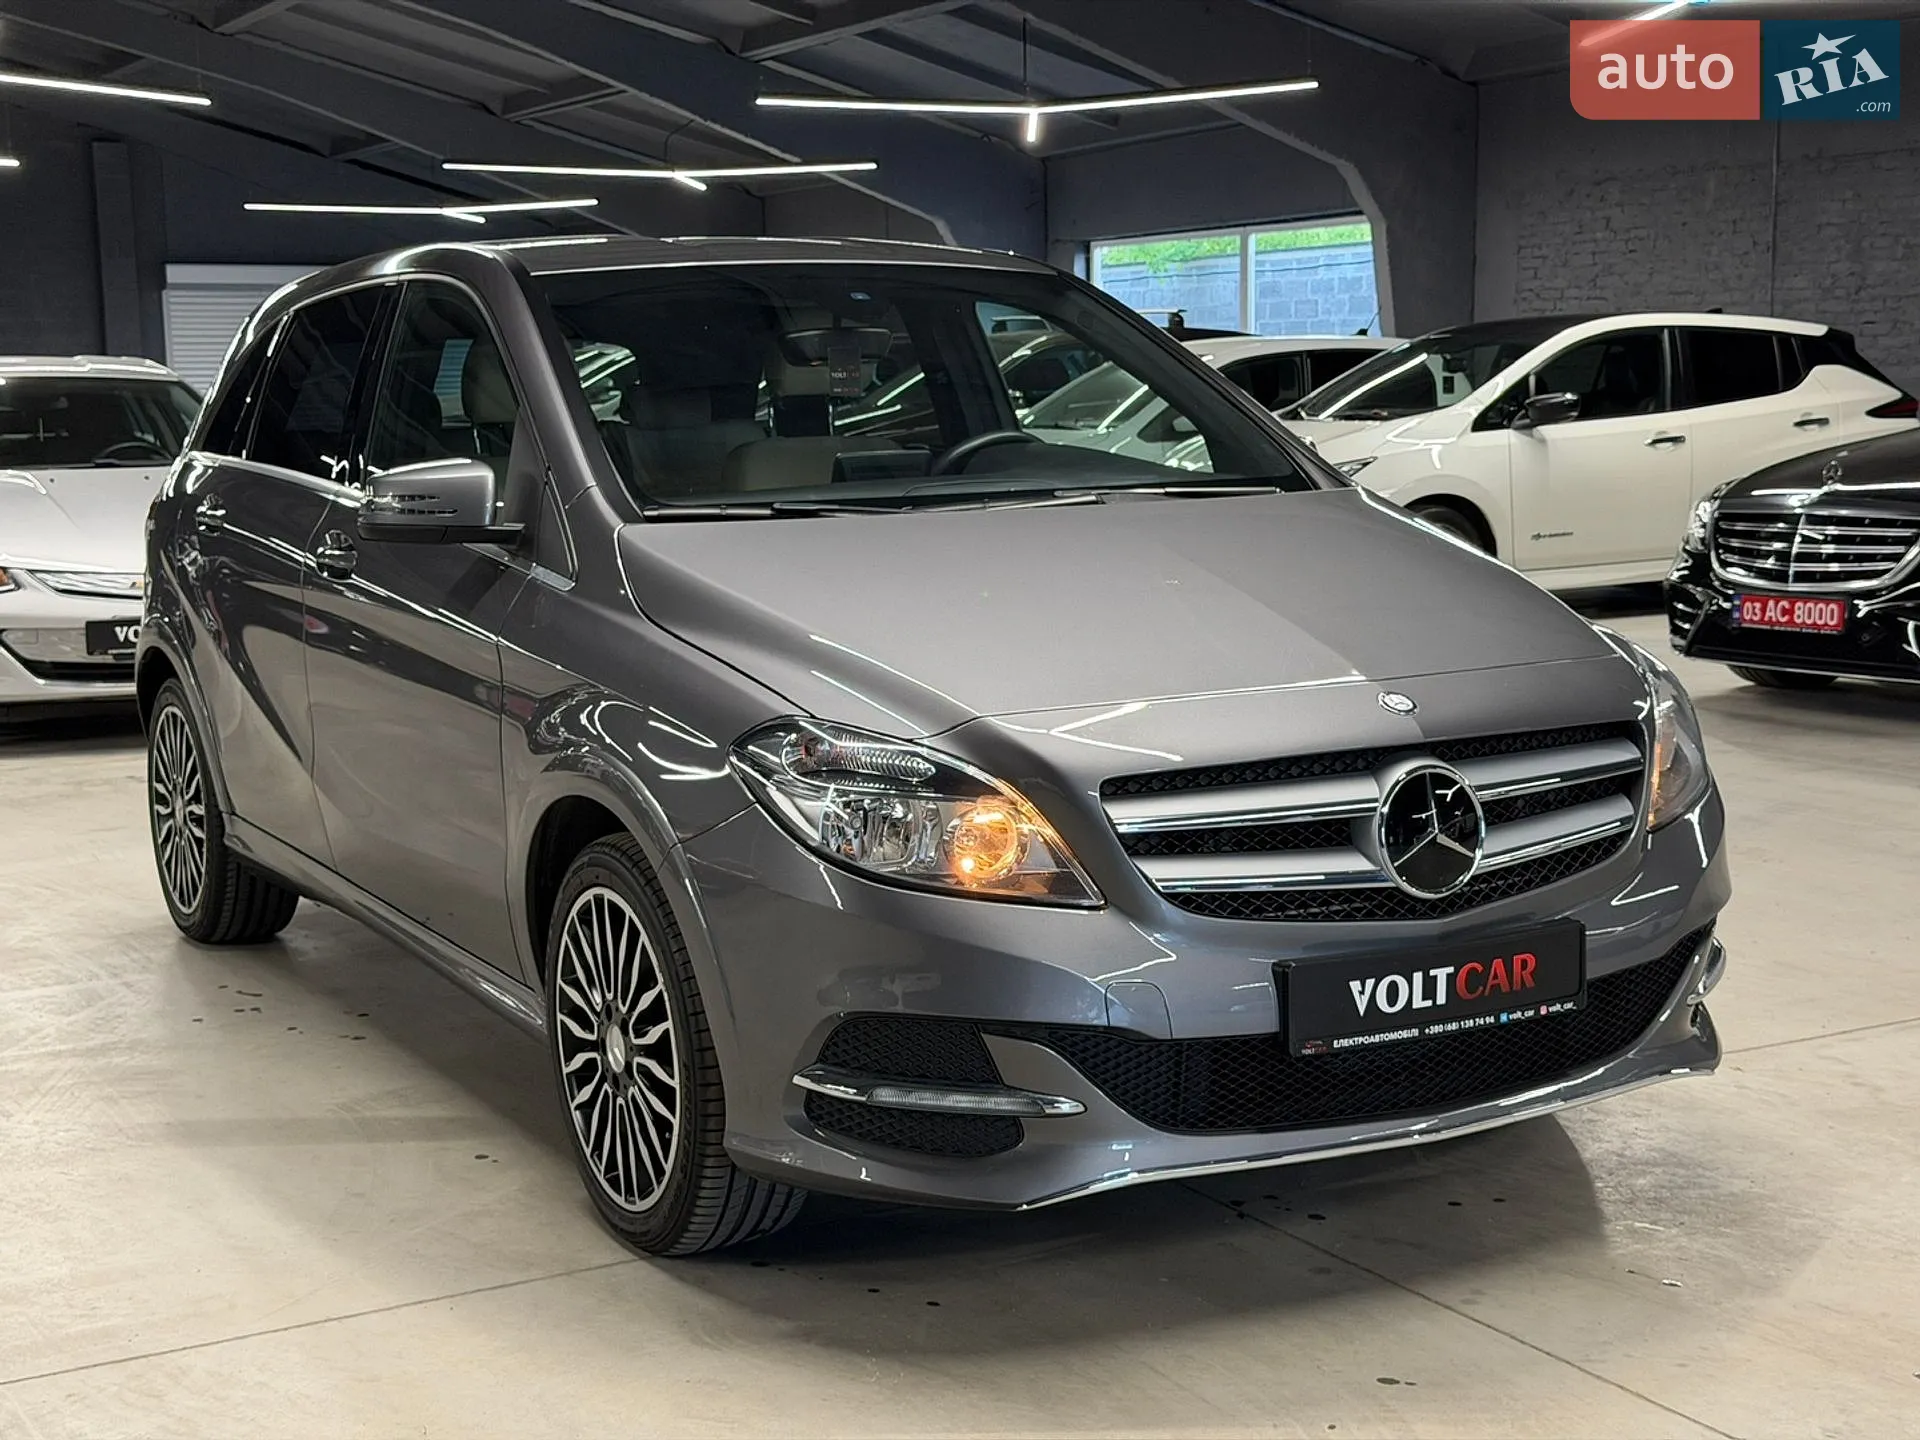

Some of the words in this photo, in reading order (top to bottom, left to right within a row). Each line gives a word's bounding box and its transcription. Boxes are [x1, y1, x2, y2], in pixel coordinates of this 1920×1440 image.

[1743, 601, 1762, 621] 03
[1764, 599, 1790, 622] AC
[1793, 601, 1838, 626] 8000
[1349, 953, 1537, 1017] VOLTCAR
[1333, 1028, 1419, 1048] ЕЛЕКТРОАВТОМОБІЛІ
